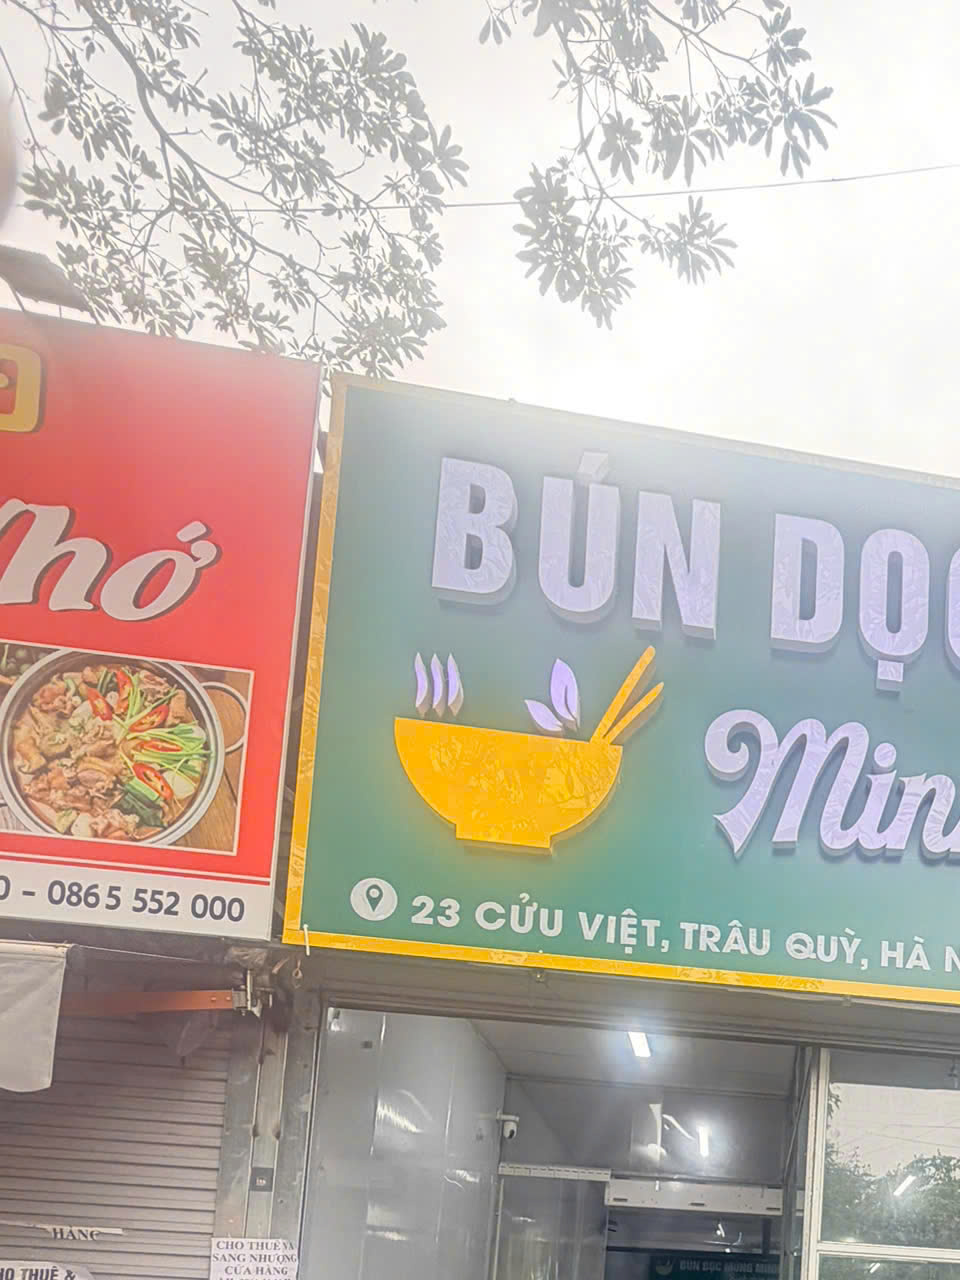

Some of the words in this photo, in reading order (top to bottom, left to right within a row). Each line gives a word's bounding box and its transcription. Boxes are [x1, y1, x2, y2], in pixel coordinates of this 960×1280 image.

[432, 451, 721, 636] BÚN
[132, 888, 180, 916] 552
[191, 894, 245, 922] 000
[411, 895, 460, 928] 23
[474, 893, 563, 937] CỬU
[578, 908, 669, 954] VIỆT,
[680, 920, 770, 956] TRÂU
[785, 928, 868, 970] QUỲ,
[881, 936, 931, 971] HÀ
[213, 1253, 246, 1262] SANG
[216, 1240, 244, 1250] CHO
